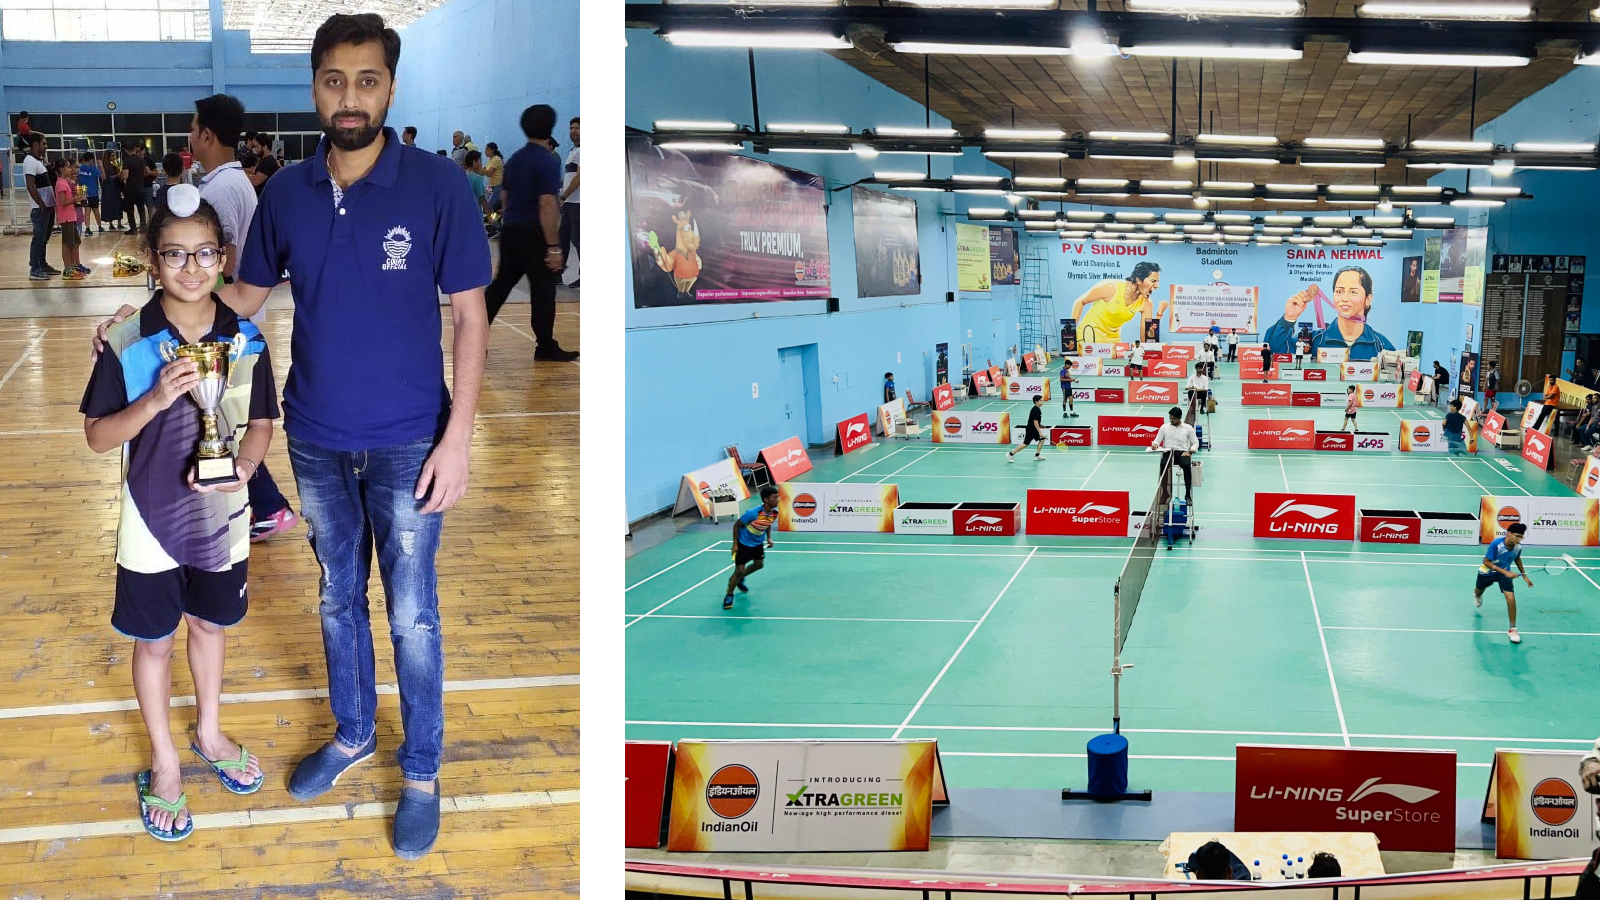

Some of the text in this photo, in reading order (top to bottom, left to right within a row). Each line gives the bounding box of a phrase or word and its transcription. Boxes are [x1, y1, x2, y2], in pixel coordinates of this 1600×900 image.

[740, 231, 804, 259] TRULY PREMIUM.
[1091, 244, 1148, 256] SINDHU
[1196, 247, 1238, 255] Badminton
[1286, 249, 1384, 260] SAINA NEHWAL
[1072, 259, 1089, 267] World
[1090, 260, 1115, 268] Champion
[1201, 257, 1233, 265] Stadium
[382, 263, 407, 271] OFFICIAL
[1067, 272, 1088, 280] Olympic
[1088, 272, 1101, 280] Silver
[971, 421, 998, 431] XP95
[847, 433, 867, 448] LI-NING
[1357, 438, 1384, 449] XP95
[1525, 448, 1544, 463] LI-NING
[828, 503, 883, 513] XTRAGREEN
[901, 516, 947, 525] XTRAGREEN
[1072, 516, 1120, 524] SuperStore
[1533, 517, 1586, 527] XTRAGREEN
[1269, 522, 1338, 534] LI-NING
[1427, 526, 1473, 535] XTRAGREEN
[708, 785, 757, 798] इंडियनऑयल
[785, 785, 903, 807] XTRAGREEN
[1250, 786, 1343, 802] LI-NING
[1335, 806, 1441, 823] SuperStore
[701, 821, 758, 832] IndianOil
[1529, 827, 1579, 838] IndianOil
